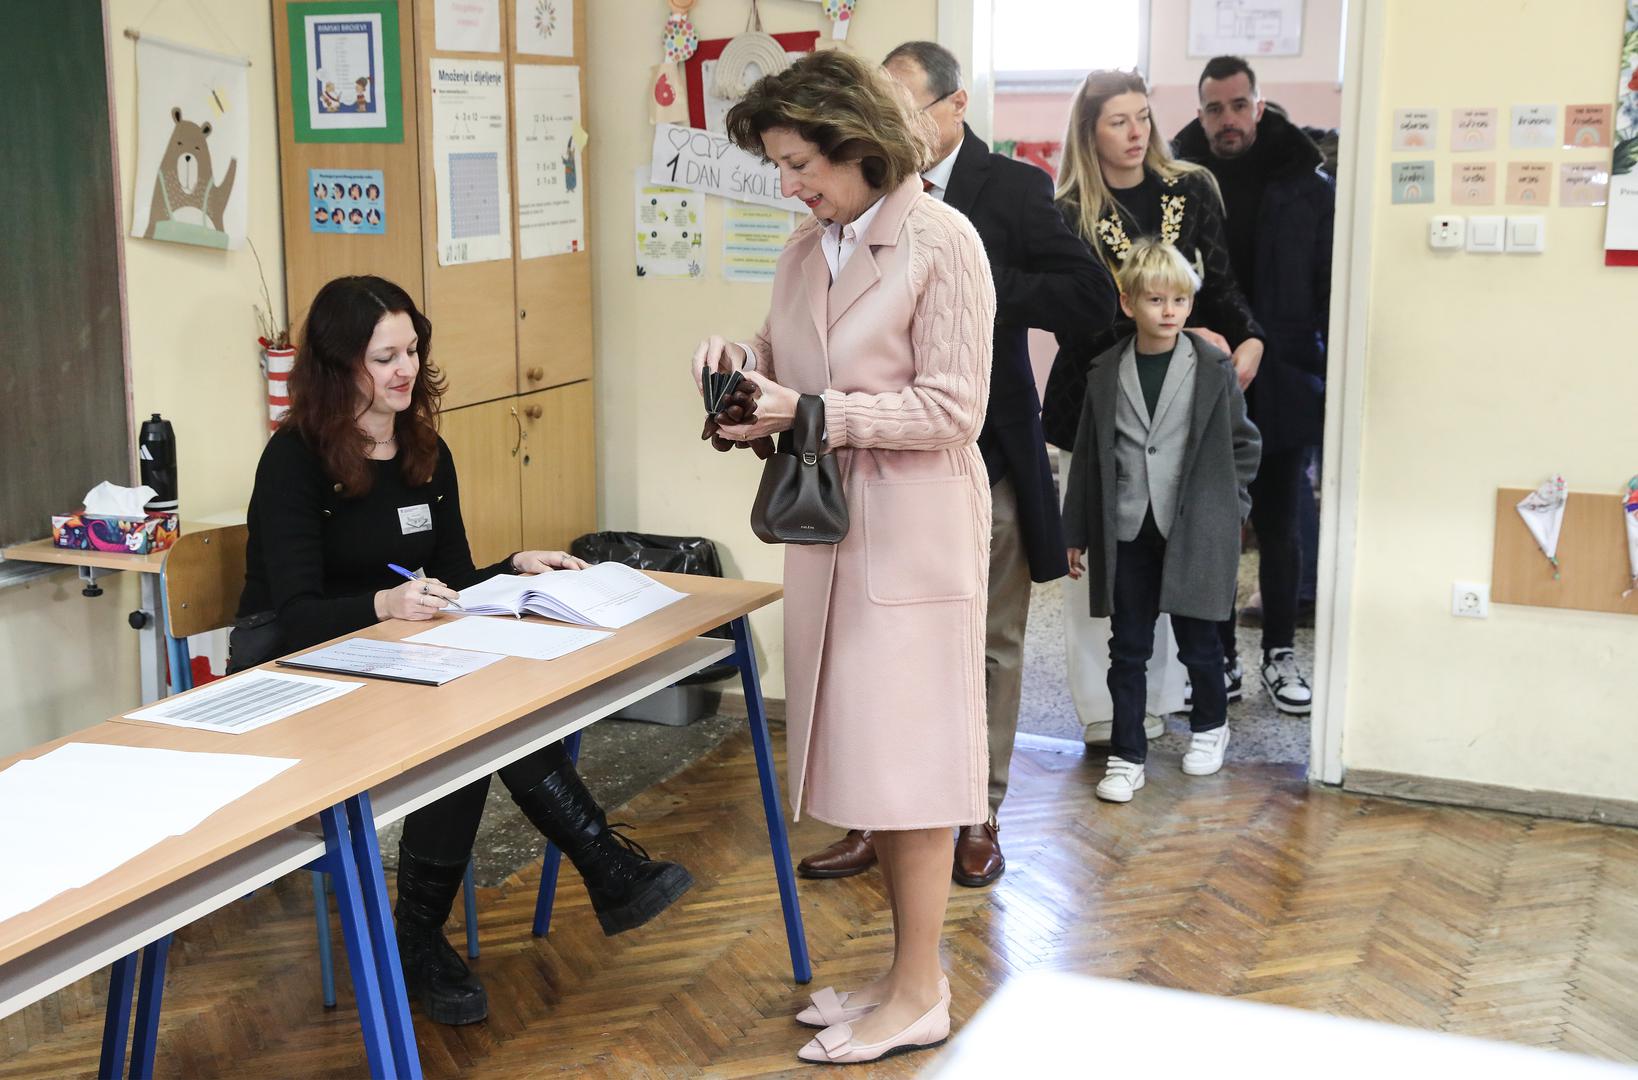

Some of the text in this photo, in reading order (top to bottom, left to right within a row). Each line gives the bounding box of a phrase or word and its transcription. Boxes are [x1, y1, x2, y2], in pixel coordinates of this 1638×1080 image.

[438, 68, 469, 85] Množenje
[474, 71, 502, 86] dijeljenje
[654, 73, 676, 107] 6
[686, 160, 721, 189] DAN
